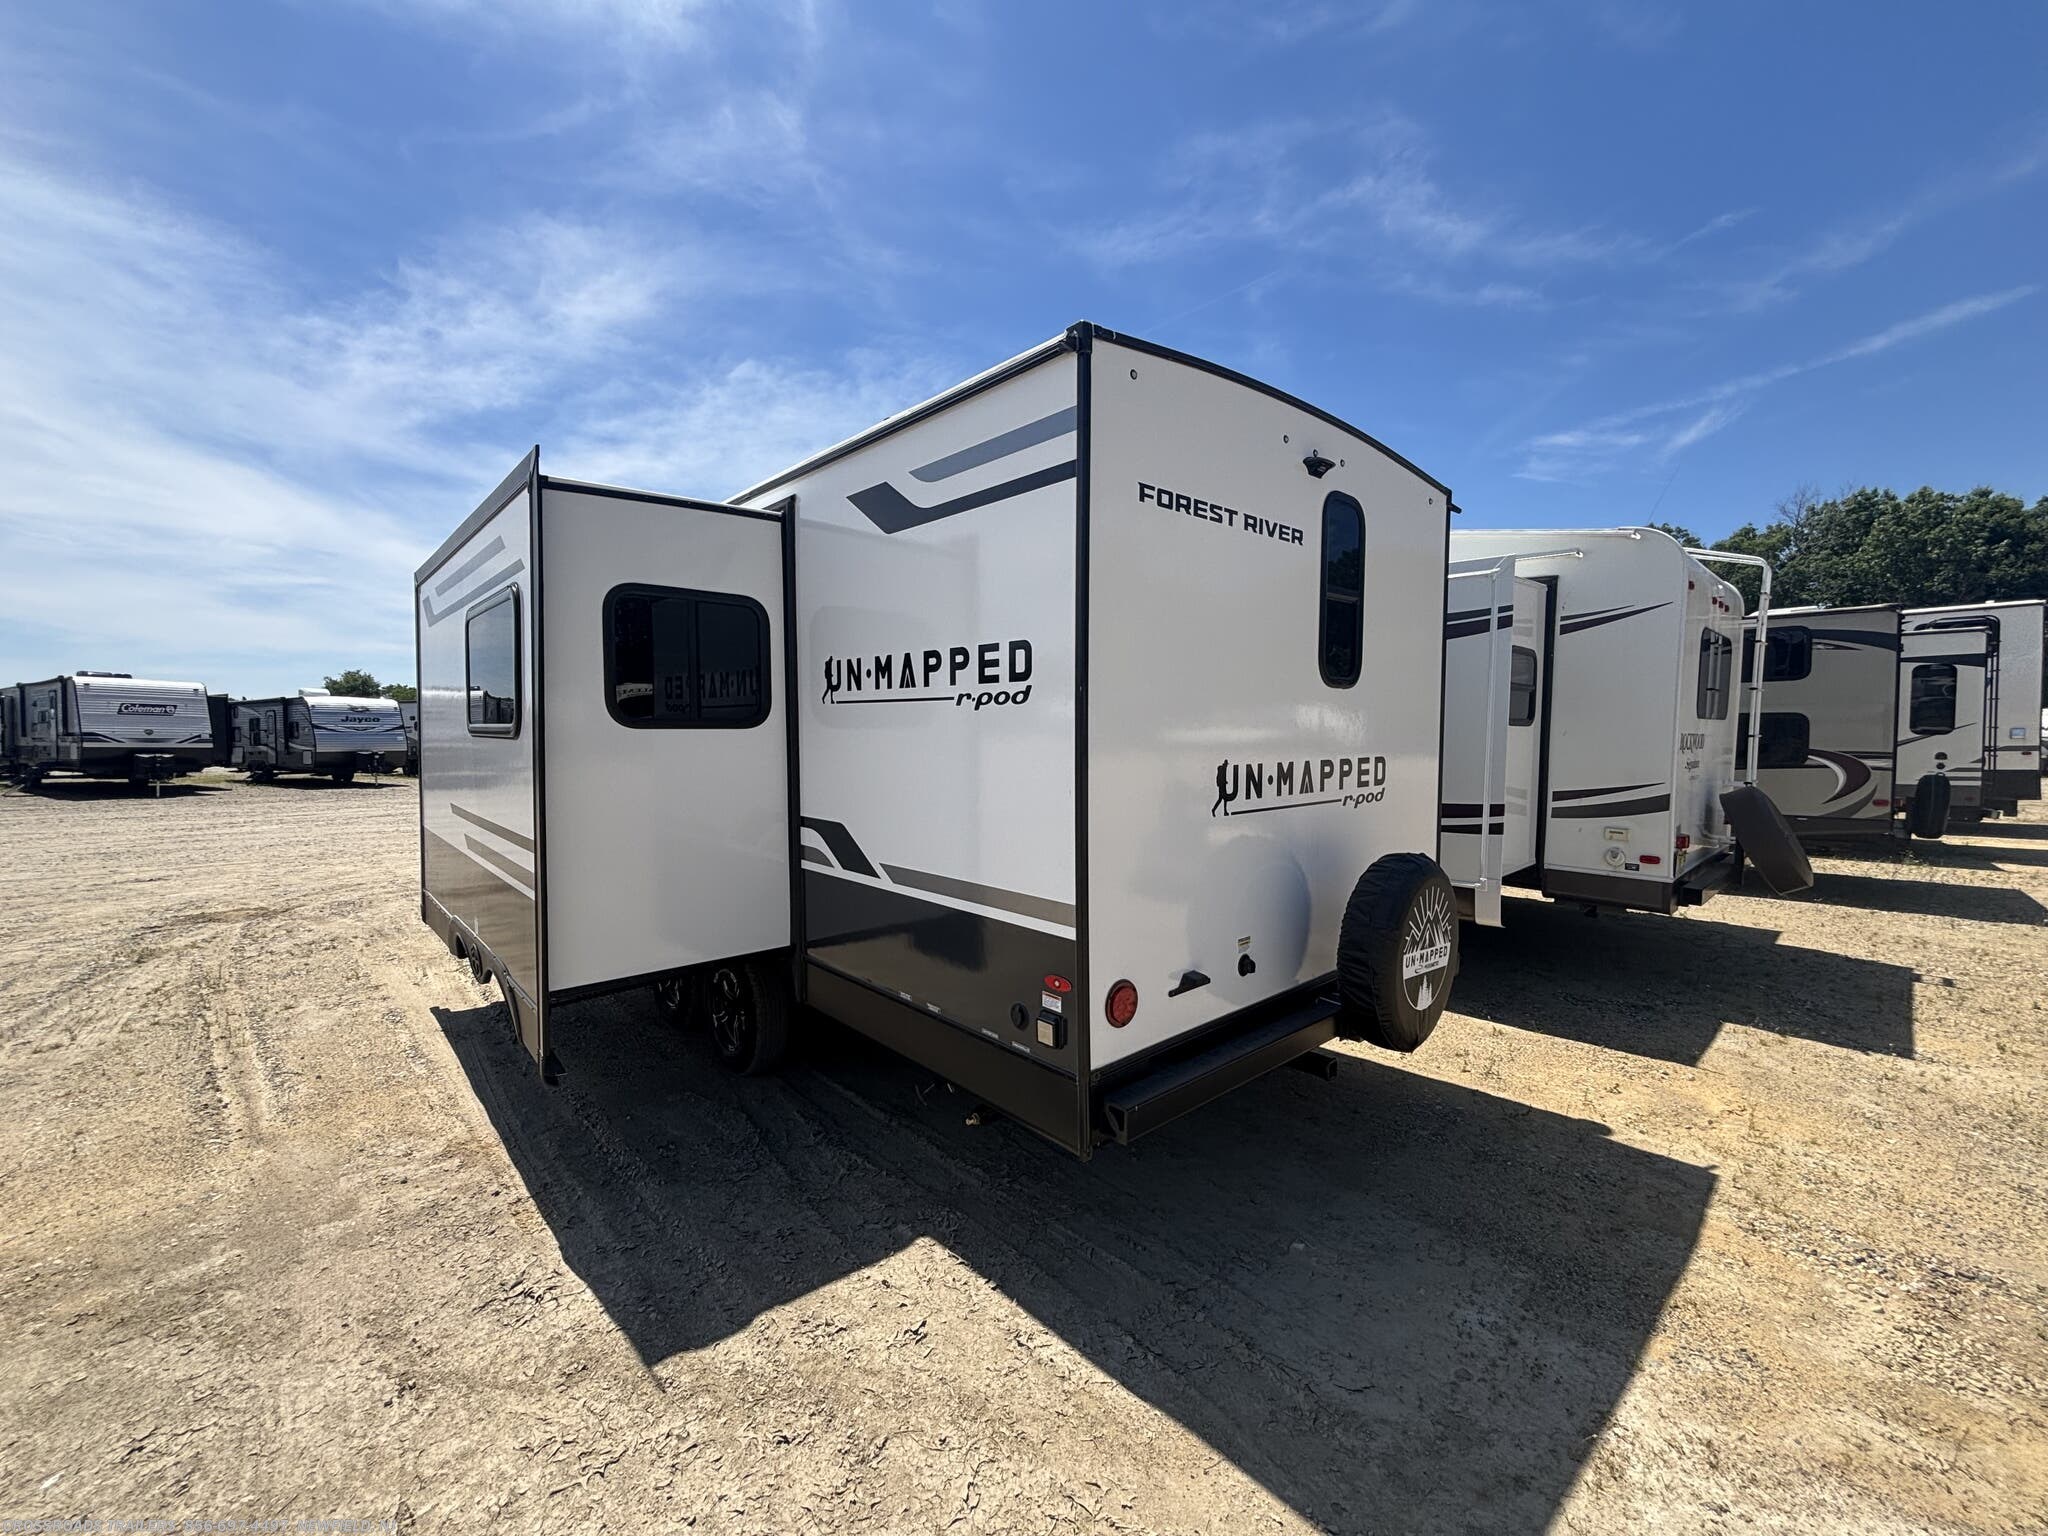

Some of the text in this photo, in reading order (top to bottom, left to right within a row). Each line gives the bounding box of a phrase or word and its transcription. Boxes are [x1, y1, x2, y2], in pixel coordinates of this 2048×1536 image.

[1137, 481, 1303, 546] FOREST RIVER
[121, 703, 165, 713] Coleman
[340, 715, 381, 724] Jayco
